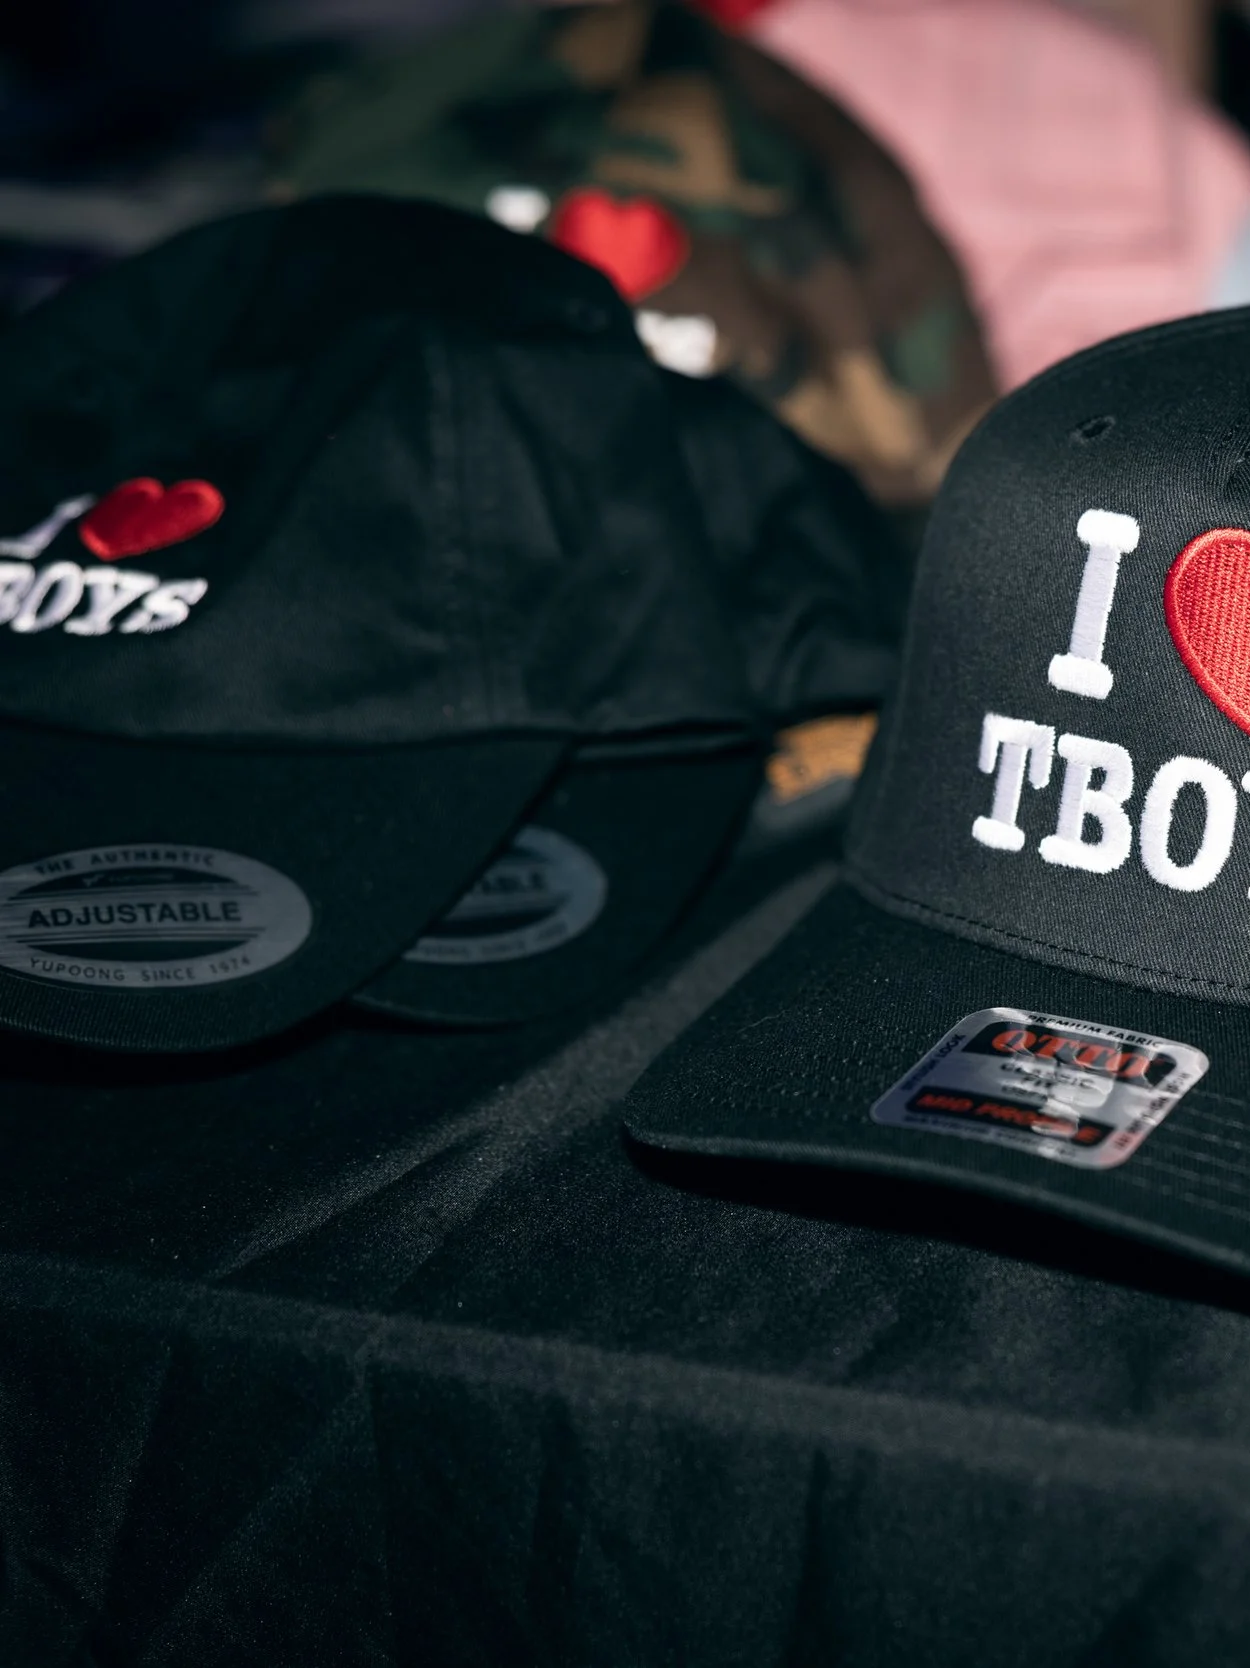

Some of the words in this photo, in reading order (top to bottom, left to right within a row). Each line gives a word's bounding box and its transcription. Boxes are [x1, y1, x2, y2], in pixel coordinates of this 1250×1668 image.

[1048, 509, 1140, 699] I
[33, 857, 76, 876] THE
[89, 850, 216, 868] AUTHENTIC
[27, 901, 243, 929] ADJUSTABLE
[29, 957, 126, 982] YUPOONG
[141, 966, 196, 983] SINCE
[209, 955, 252, 975] 1974
[1027, 1014, 1101, 1034] PREMIUM
[1106, 1030, 1164, 1048] FABRIC
[915, 1093, 973, 1113] MID
